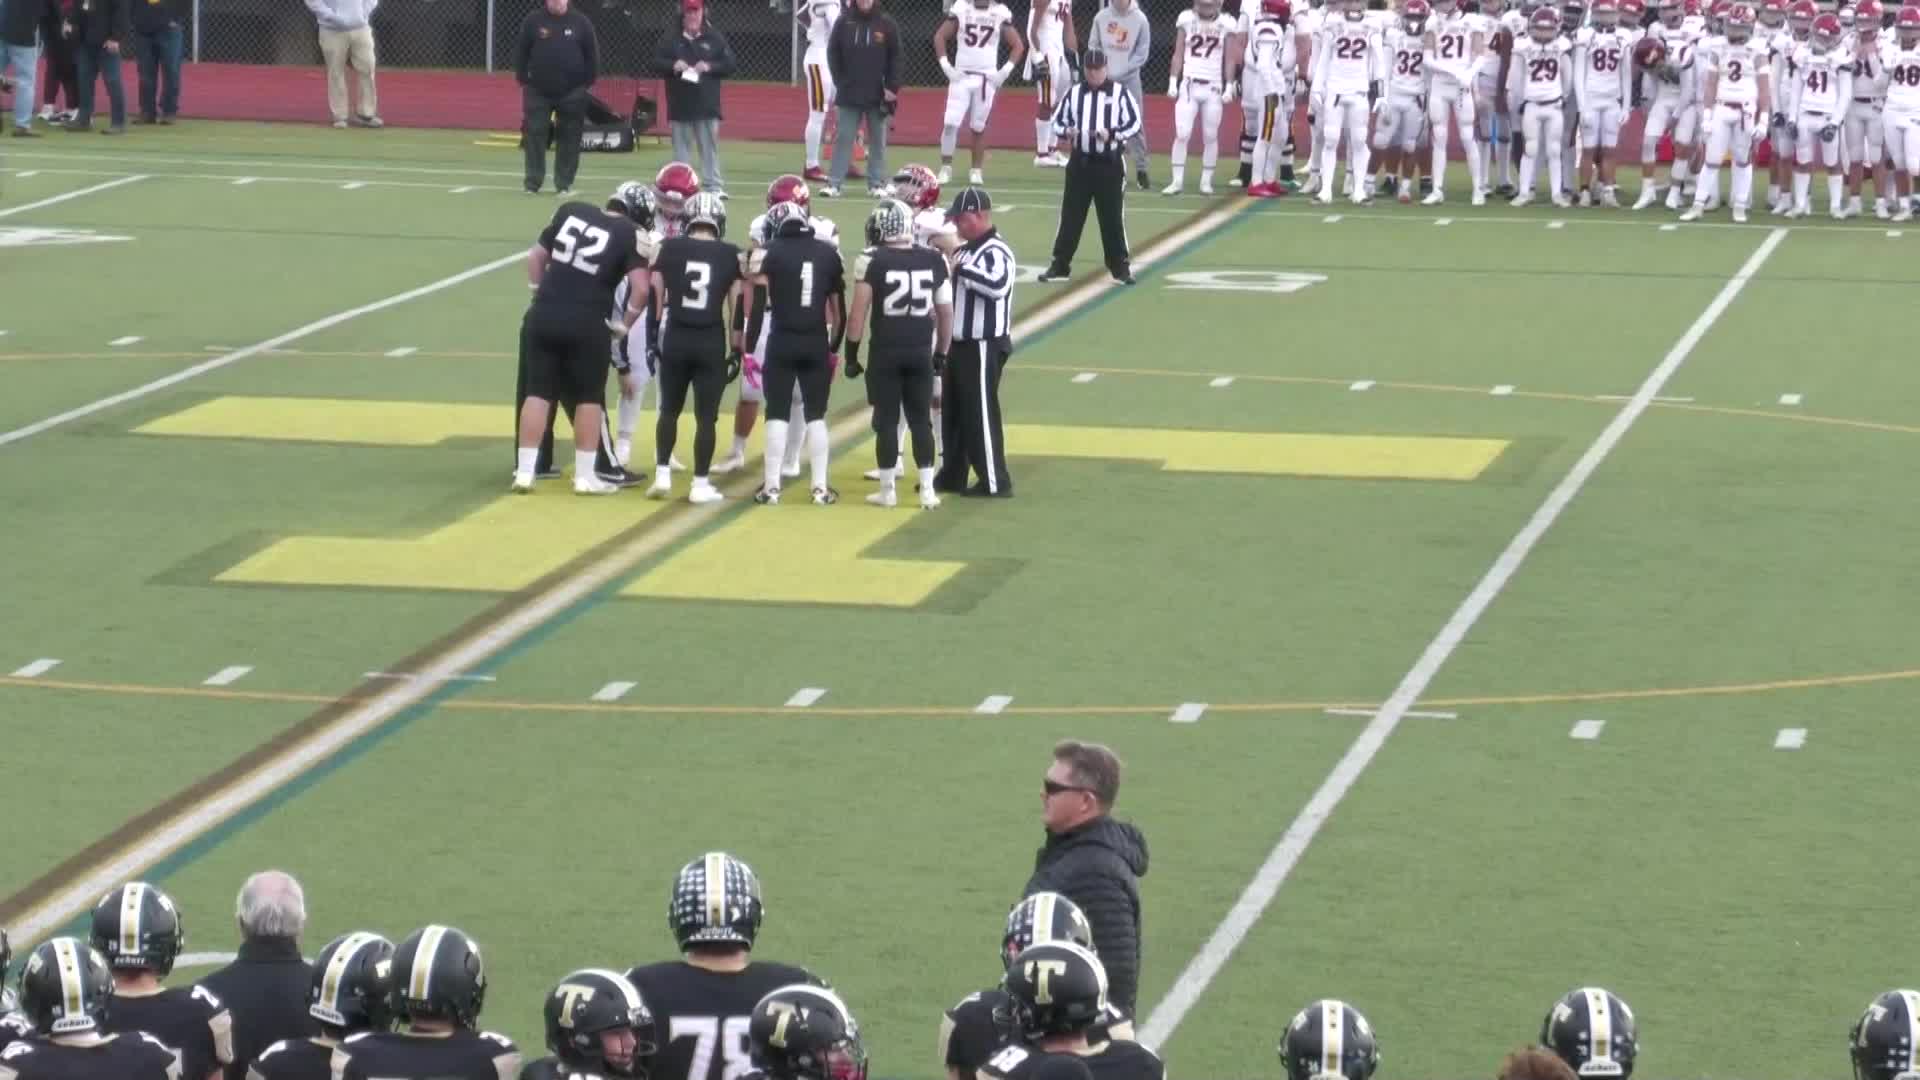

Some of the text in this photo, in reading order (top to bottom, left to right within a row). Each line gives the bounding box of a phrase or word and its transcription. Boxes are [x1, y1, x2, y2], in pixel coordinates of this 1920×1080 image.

[964, 24, 994, 48] 57
[1191, 34, 1219, 58] 27
[1336, 37, 1367, 59] 22
[1441, 34, 1464, 58] 21
[1397, 50, 1424, 76] 32
[1529, 58, 1558, 82] 29
[1593, 48, 1620, 72] 85
[1807, 70, 1827, 93] 41
[551, 215, 610, 276] 52
[681, 261, 711, 310] 3
[799, 262, 814, 308] 1
[883, 269, 935, 317] 25
[1023, 959, 1067, 1005] T
[555, 983, 596, 1029] T
